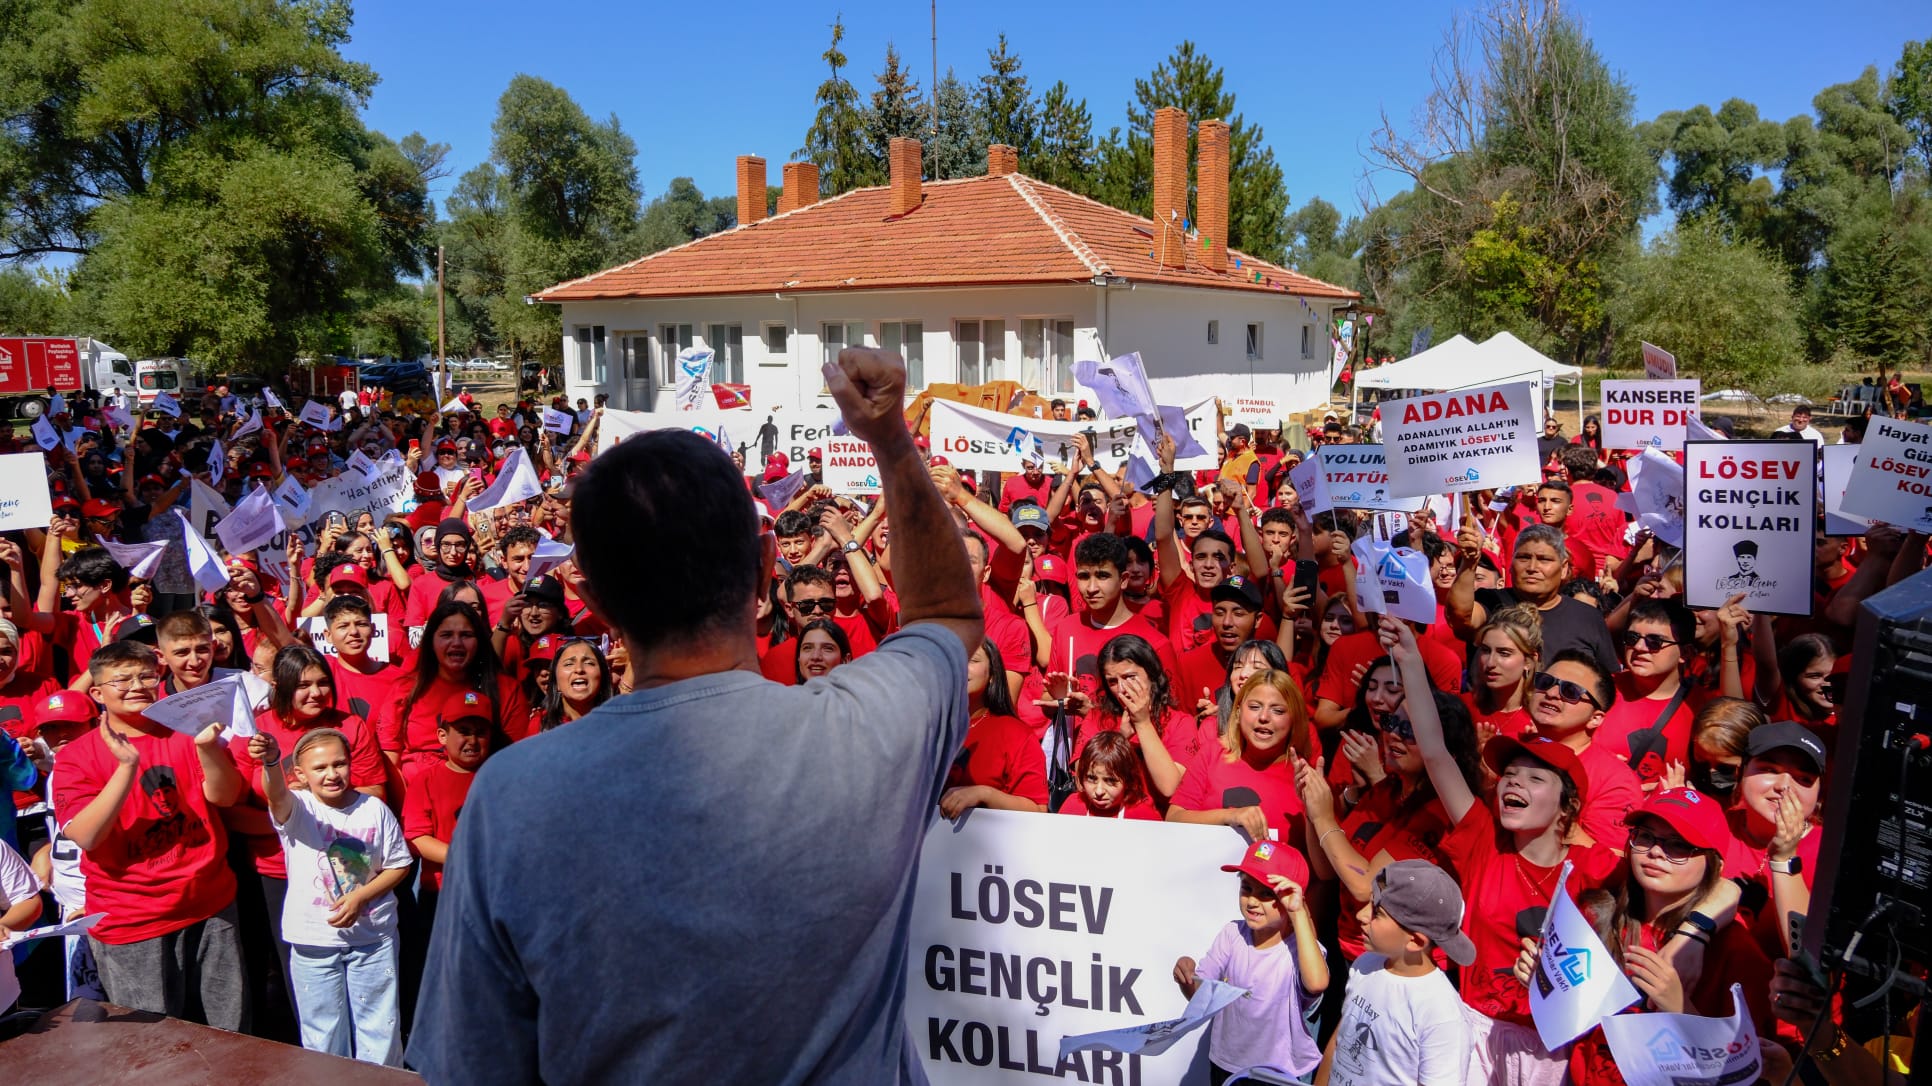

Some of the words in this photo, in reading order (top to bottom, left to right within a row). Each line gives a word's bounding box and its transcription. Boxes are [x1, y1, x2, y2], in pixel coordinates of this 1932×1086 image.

[1236, 398, 1276, 407] İSTANBUL
[1606, 390, 1696, 404] KANSERE
[1402, 391, 1509, 425] ADANA
[1607, 409, 1655, 426] DUR
[1397, 426, 1463, 442] ADANALIYIK
[1878, 424, 1930, 445] Hayat
[944, 435, 1012, 455] LÖSEV
[1403, 439, 1457, 453] ADAMIYIK
[829, 457, 876, 468] ANADO
[1324, 454, 1387, 465] YOLUM
[1408, 452, 1448, 465] DİMDİK
[1452, 445, 1514, 460] AYAKTAYIK
[1903, 447, 1932, 464] Güz
[1700, 456, 1801, 480] LÖSEV
[1870, 457, 1931, 479] LÖSEV
[1444, 474, 1469, 484] LÖSEV
[1897, 479, 1932, 498] KOL
[1698, 486, 1801, 509] GENÇLİK
[1698, 514, 1800, 532] KOLLARI
[950, 864, 1114, 935] LÖSEV
[924, 944, 1145, 1016] GENÇLİK
[1351, 994, 1366, 1010] All
[1364, 1003, 1380, 1022] day
